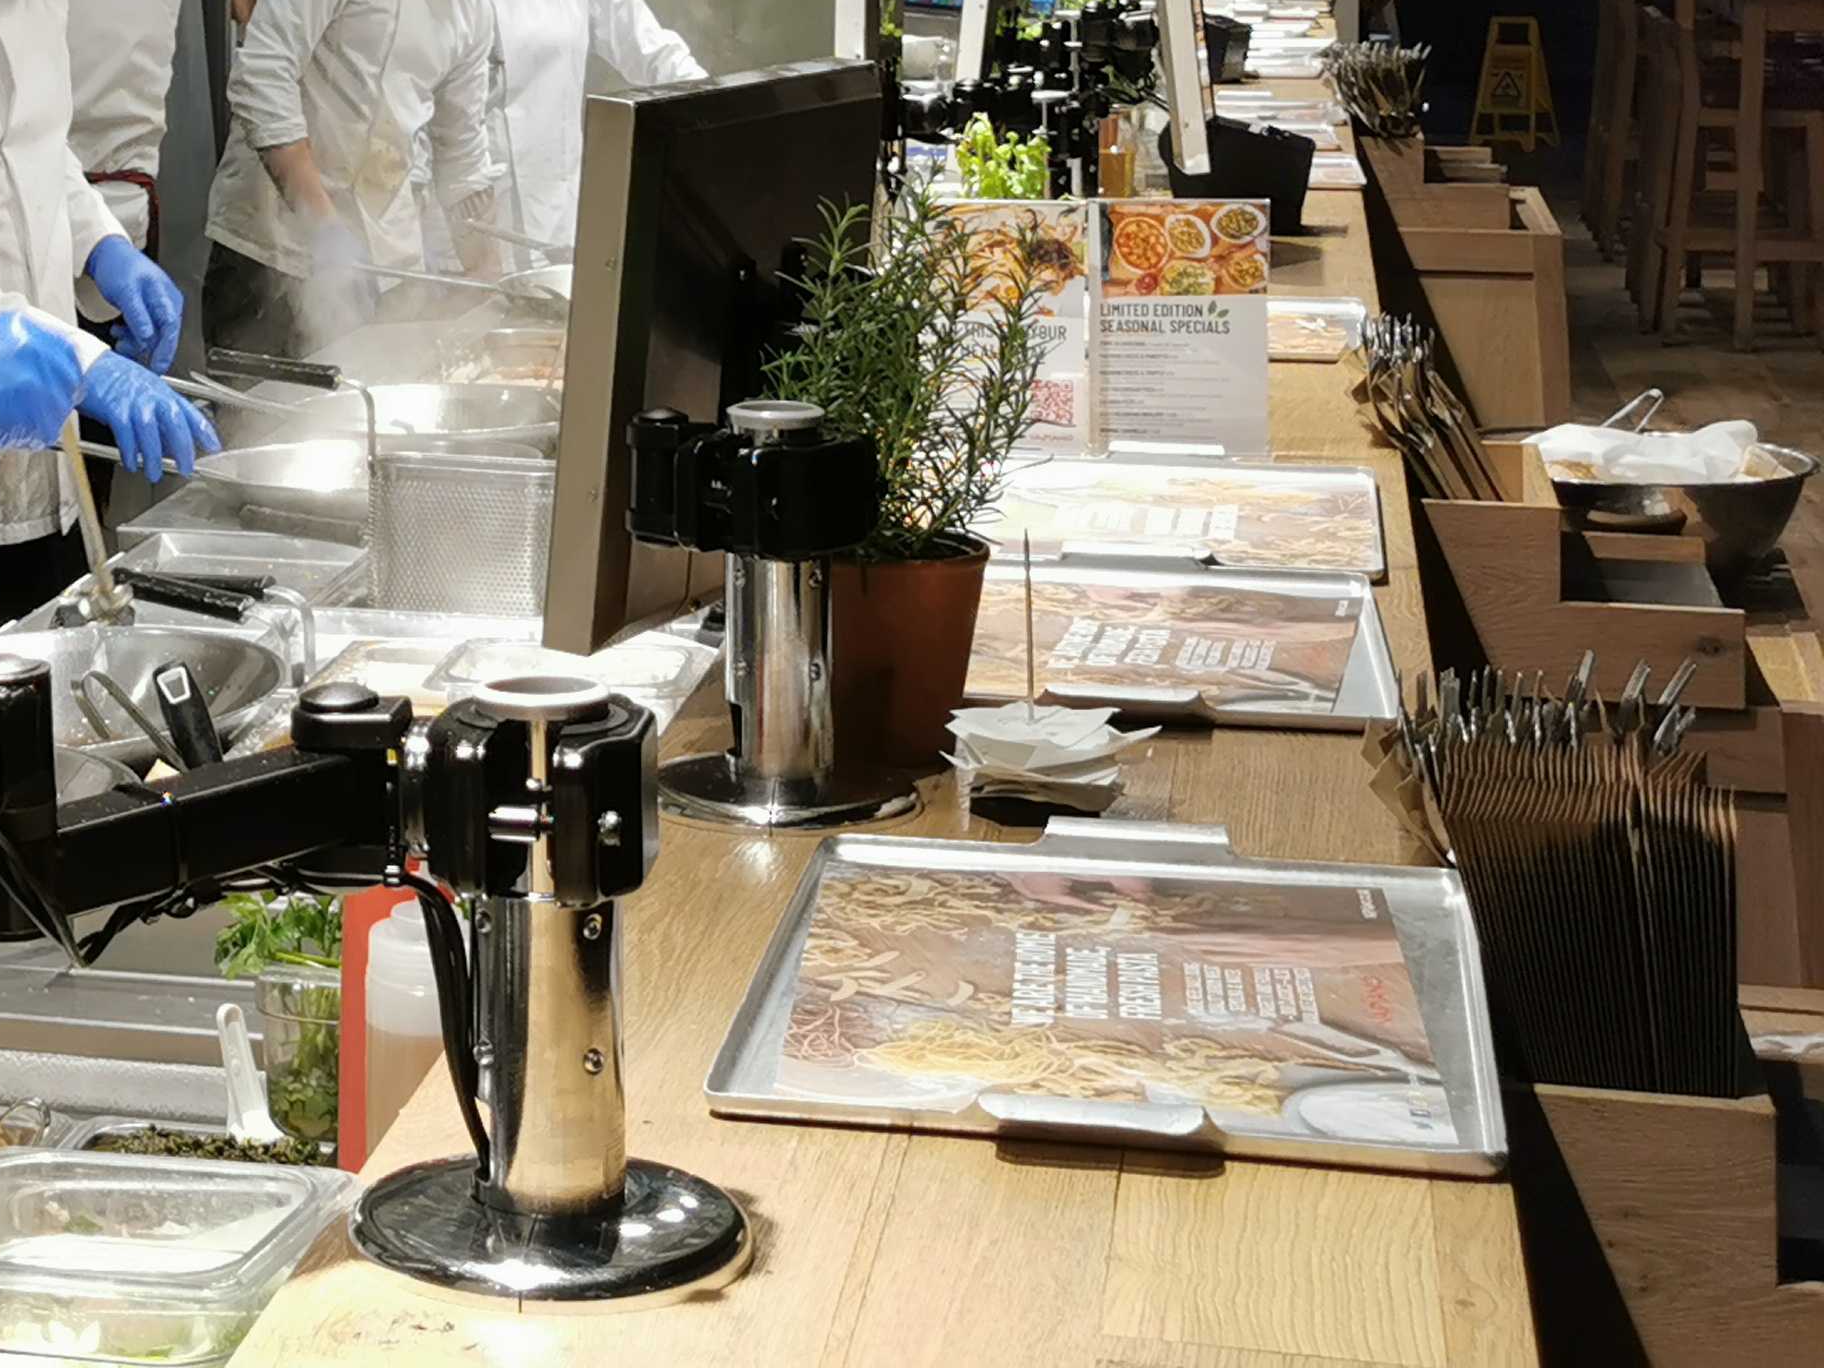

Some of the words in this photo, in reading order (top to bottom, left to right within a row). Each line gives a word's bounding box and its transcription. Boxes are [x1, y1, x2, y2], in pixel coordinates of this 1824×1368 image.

[1099, 303, 1149, 318] LIMITED
[1152, 303, 1204, 318] EDITION
[1099, 319, 1166, 334] SEASONAL
[1170, 320, 1231, 335] SPECIALS
[1015, 933, 1056, 962] HOME
[1013, 961, 1056, 981] THE
[1116, 953, 1161, 983] PASTA
[1012, 982, 1056, 1008] ARE
[1118, 983, 1162, 1020] FRESH
